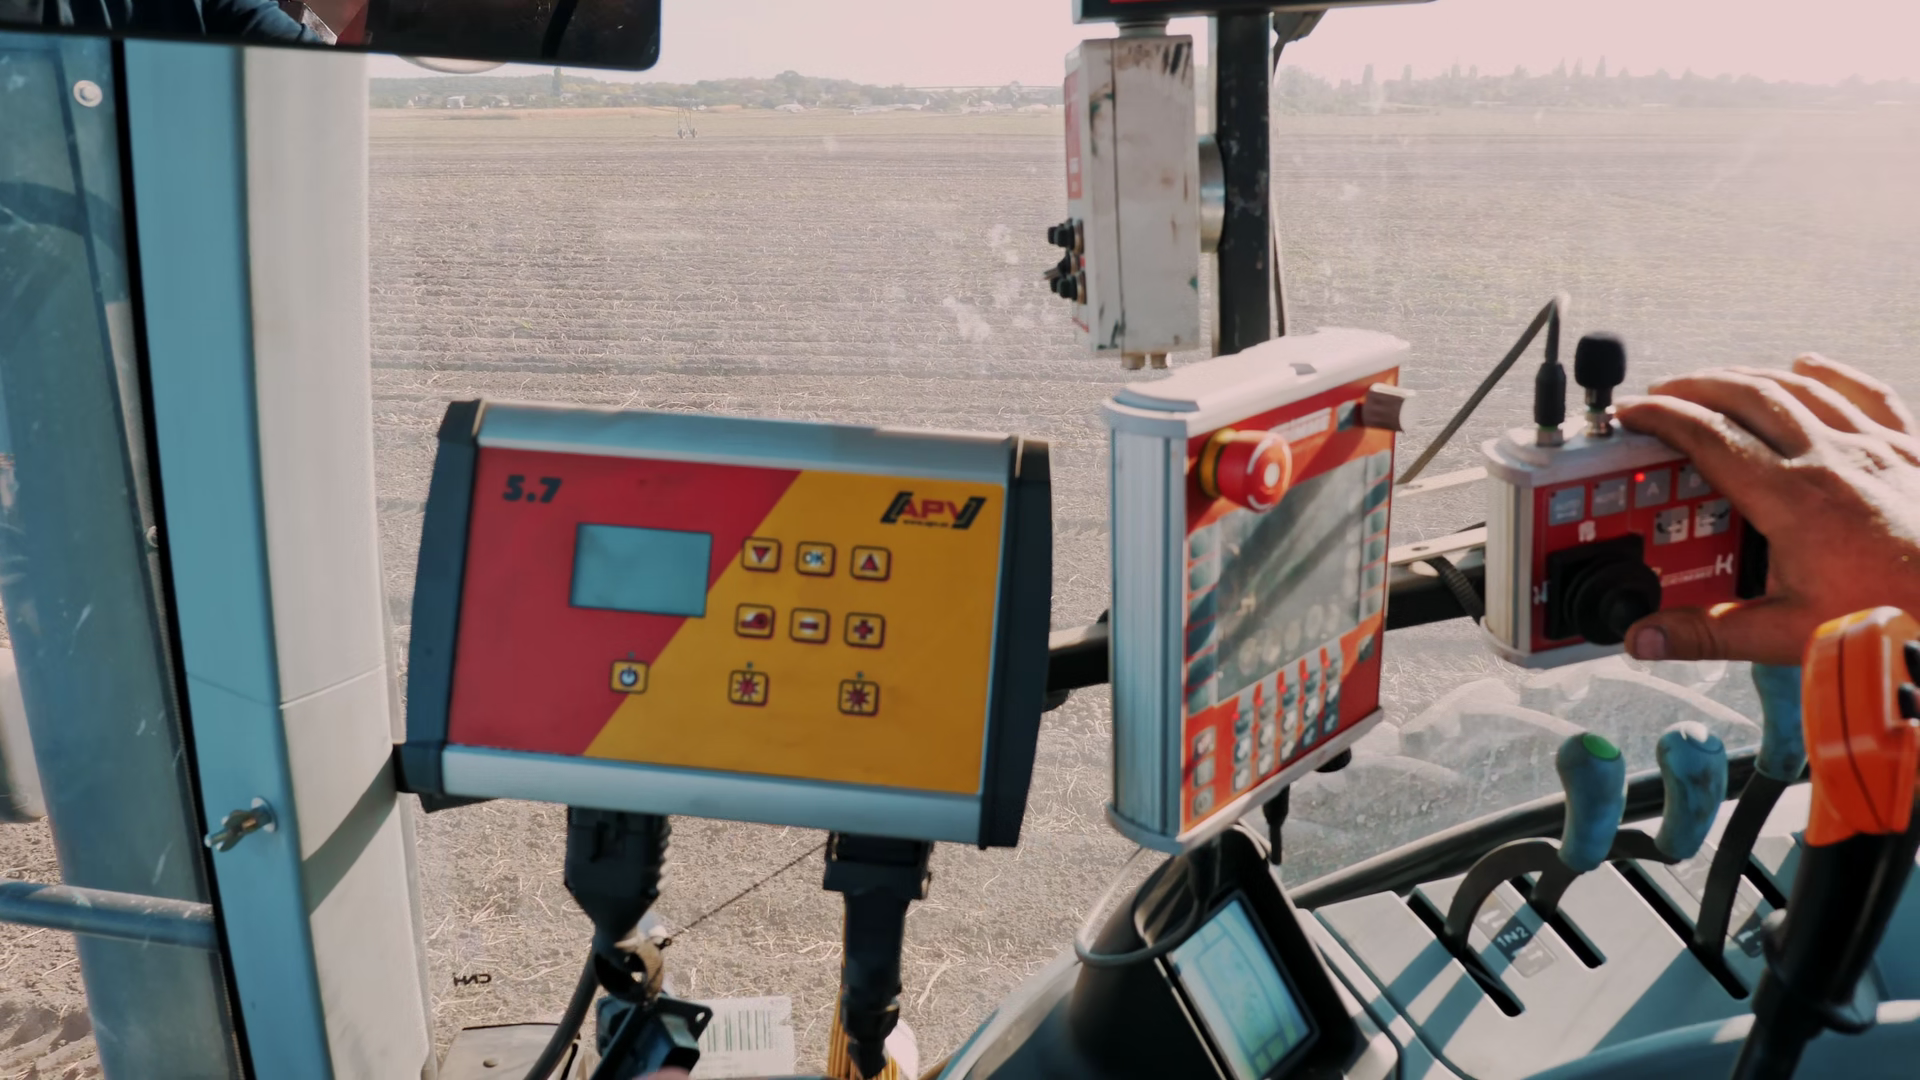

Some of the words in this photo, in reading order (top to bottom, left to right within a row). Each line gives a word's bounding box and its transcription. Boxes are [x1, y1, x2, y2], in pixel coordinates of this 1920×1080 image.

[503, 475, 562, 503] 5.7
[1646, 481, 1659, 497] A
[803, 552, 825, 565] OK
[1496, 926, 1529, 948] 1N2
